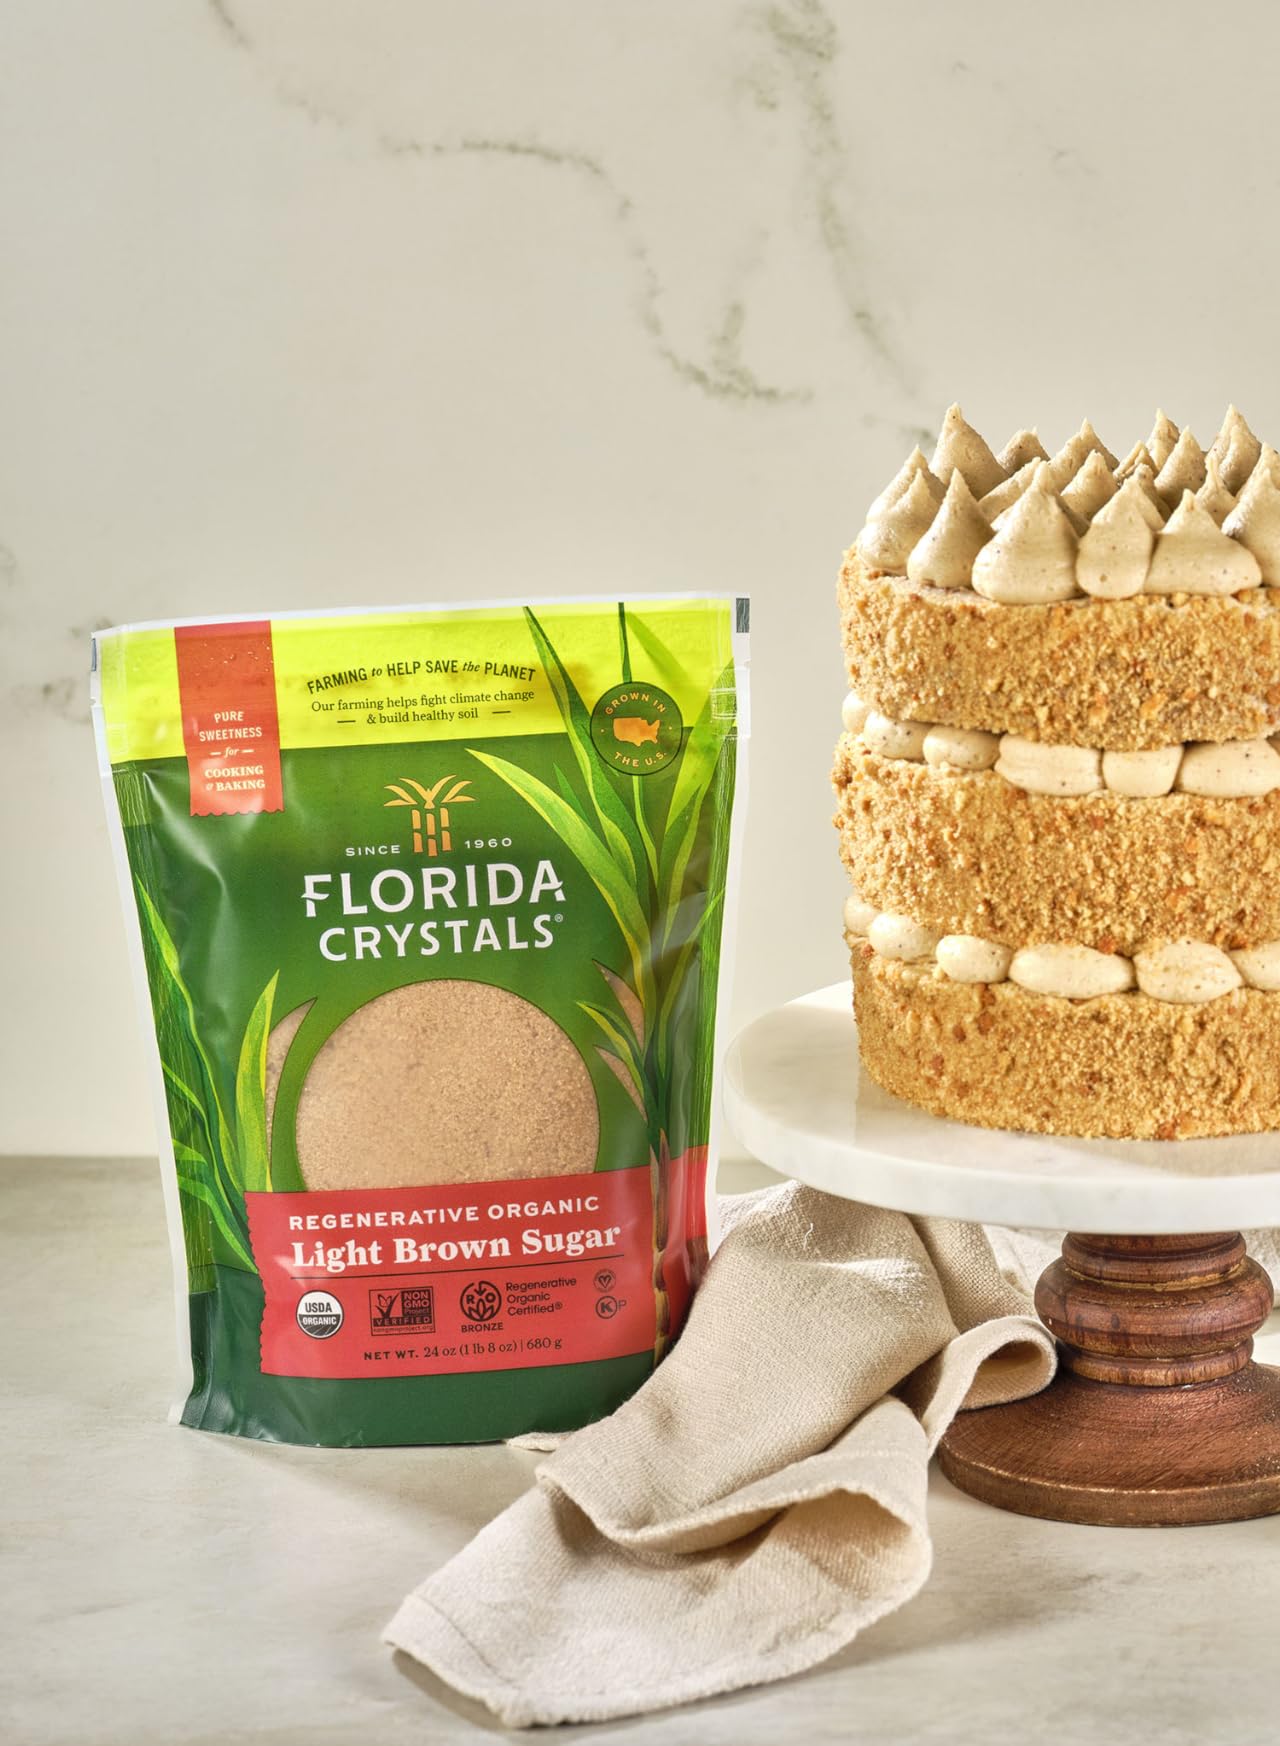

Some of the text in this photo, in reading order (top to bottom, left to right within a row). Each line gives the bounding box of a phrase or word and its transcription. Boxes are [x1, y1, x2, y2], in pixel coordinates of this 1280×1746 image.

[307, 660, 536, 694] FARMING to HELP SAVE the PLANET
[311, 690, 535, 712] Our farming helps fight climate change
[605, 692, 666, 715] GROWN IN
[214, 710, 244, 723] PURE
[367, 707, 478, 724] & build healthy soil
[199, 726, 263, 742] SWEETNESS
[224, 746, 239, 758] for
[614, 752, 666, 767] THE U.S.
[204, 765, 264, 778] COOKING
[215, 779, 265, 792] BAKING
[346, 837, 512, 856] SINCE 1960
[301, 860, 566, 917] FLORIDA
[289, 1196, 600, 1231] REGENERATIVE ORGANIC
[292, 1226, 621, 1273] Light Brown Sugar
[506, 1277, 577, 1292] Regenerative
[404, 1292, 429, 1300] NON
[507, 1292, 550, 1306] Organic
[305, 1302, 332, 1313] USDA
[404, 1300, 430, 1308] GMO
[302, 1316, 337, 1326] ORGANIC
[376, 1317, 430, 1326] VERIFIED
[461, 1322, 503, 1333] BRONZE
[364, 1352, 390, 1360] NET
[395, 1350, 419, 1359] WT.
[424, 1346, 440, 1357] 24
[460, 1344, 469, 1356] (1
[473, 1343, 484, 1354] lb
[488, 1343, 495, 1352] 8
[499, 1340, 518, 1352] oz)
[527, 1338, 551, 1349] 680
